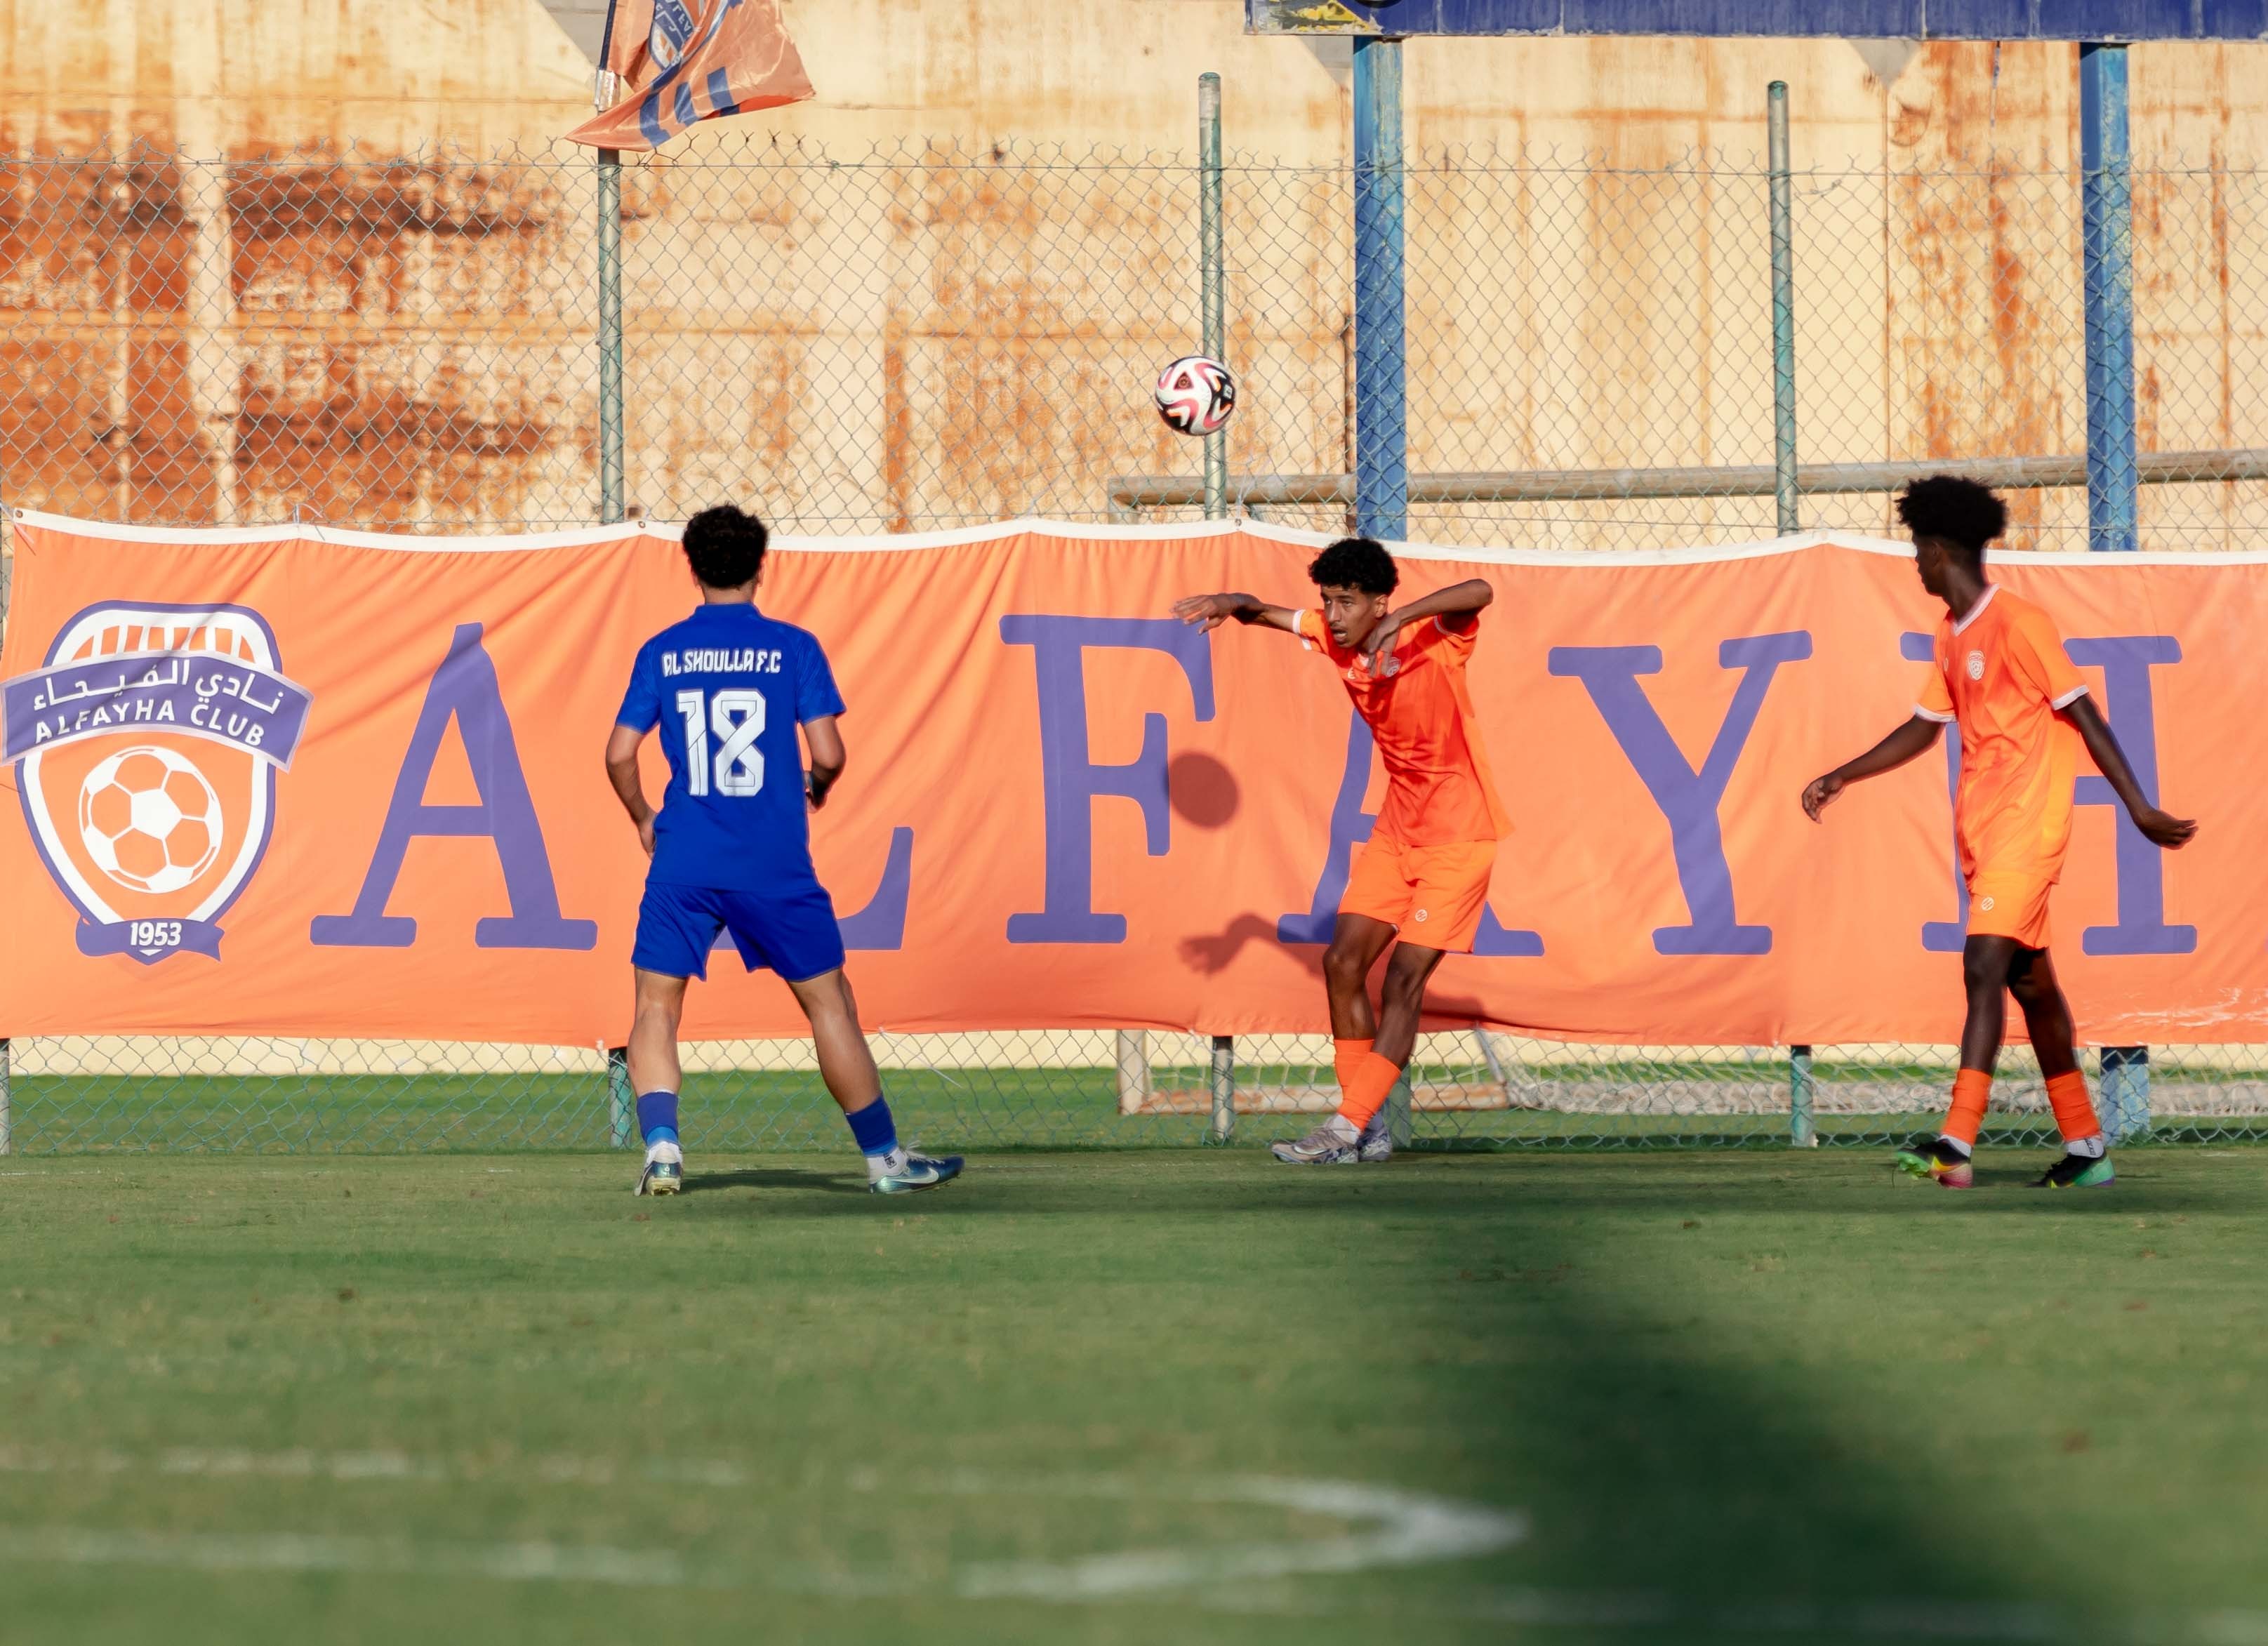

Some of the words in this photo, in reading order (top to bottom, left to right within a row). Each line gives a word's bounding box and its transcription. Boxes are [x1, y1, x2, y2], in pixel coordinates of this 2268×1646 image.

[34, 660, 190, 710] الفيحاء
[663, 652, 681, 677] AL
[684, 649, 754, 673] SHOULLA
[756, 651, 781, 673] F.C
[194, 672, 284, 715] نادي
[35, 699, 175, 743] ALFAYHA
[190, 704, 265, 746] CLUB
[677, 689, 766, 797] 18
[131, 922, 182, 947] 1953
